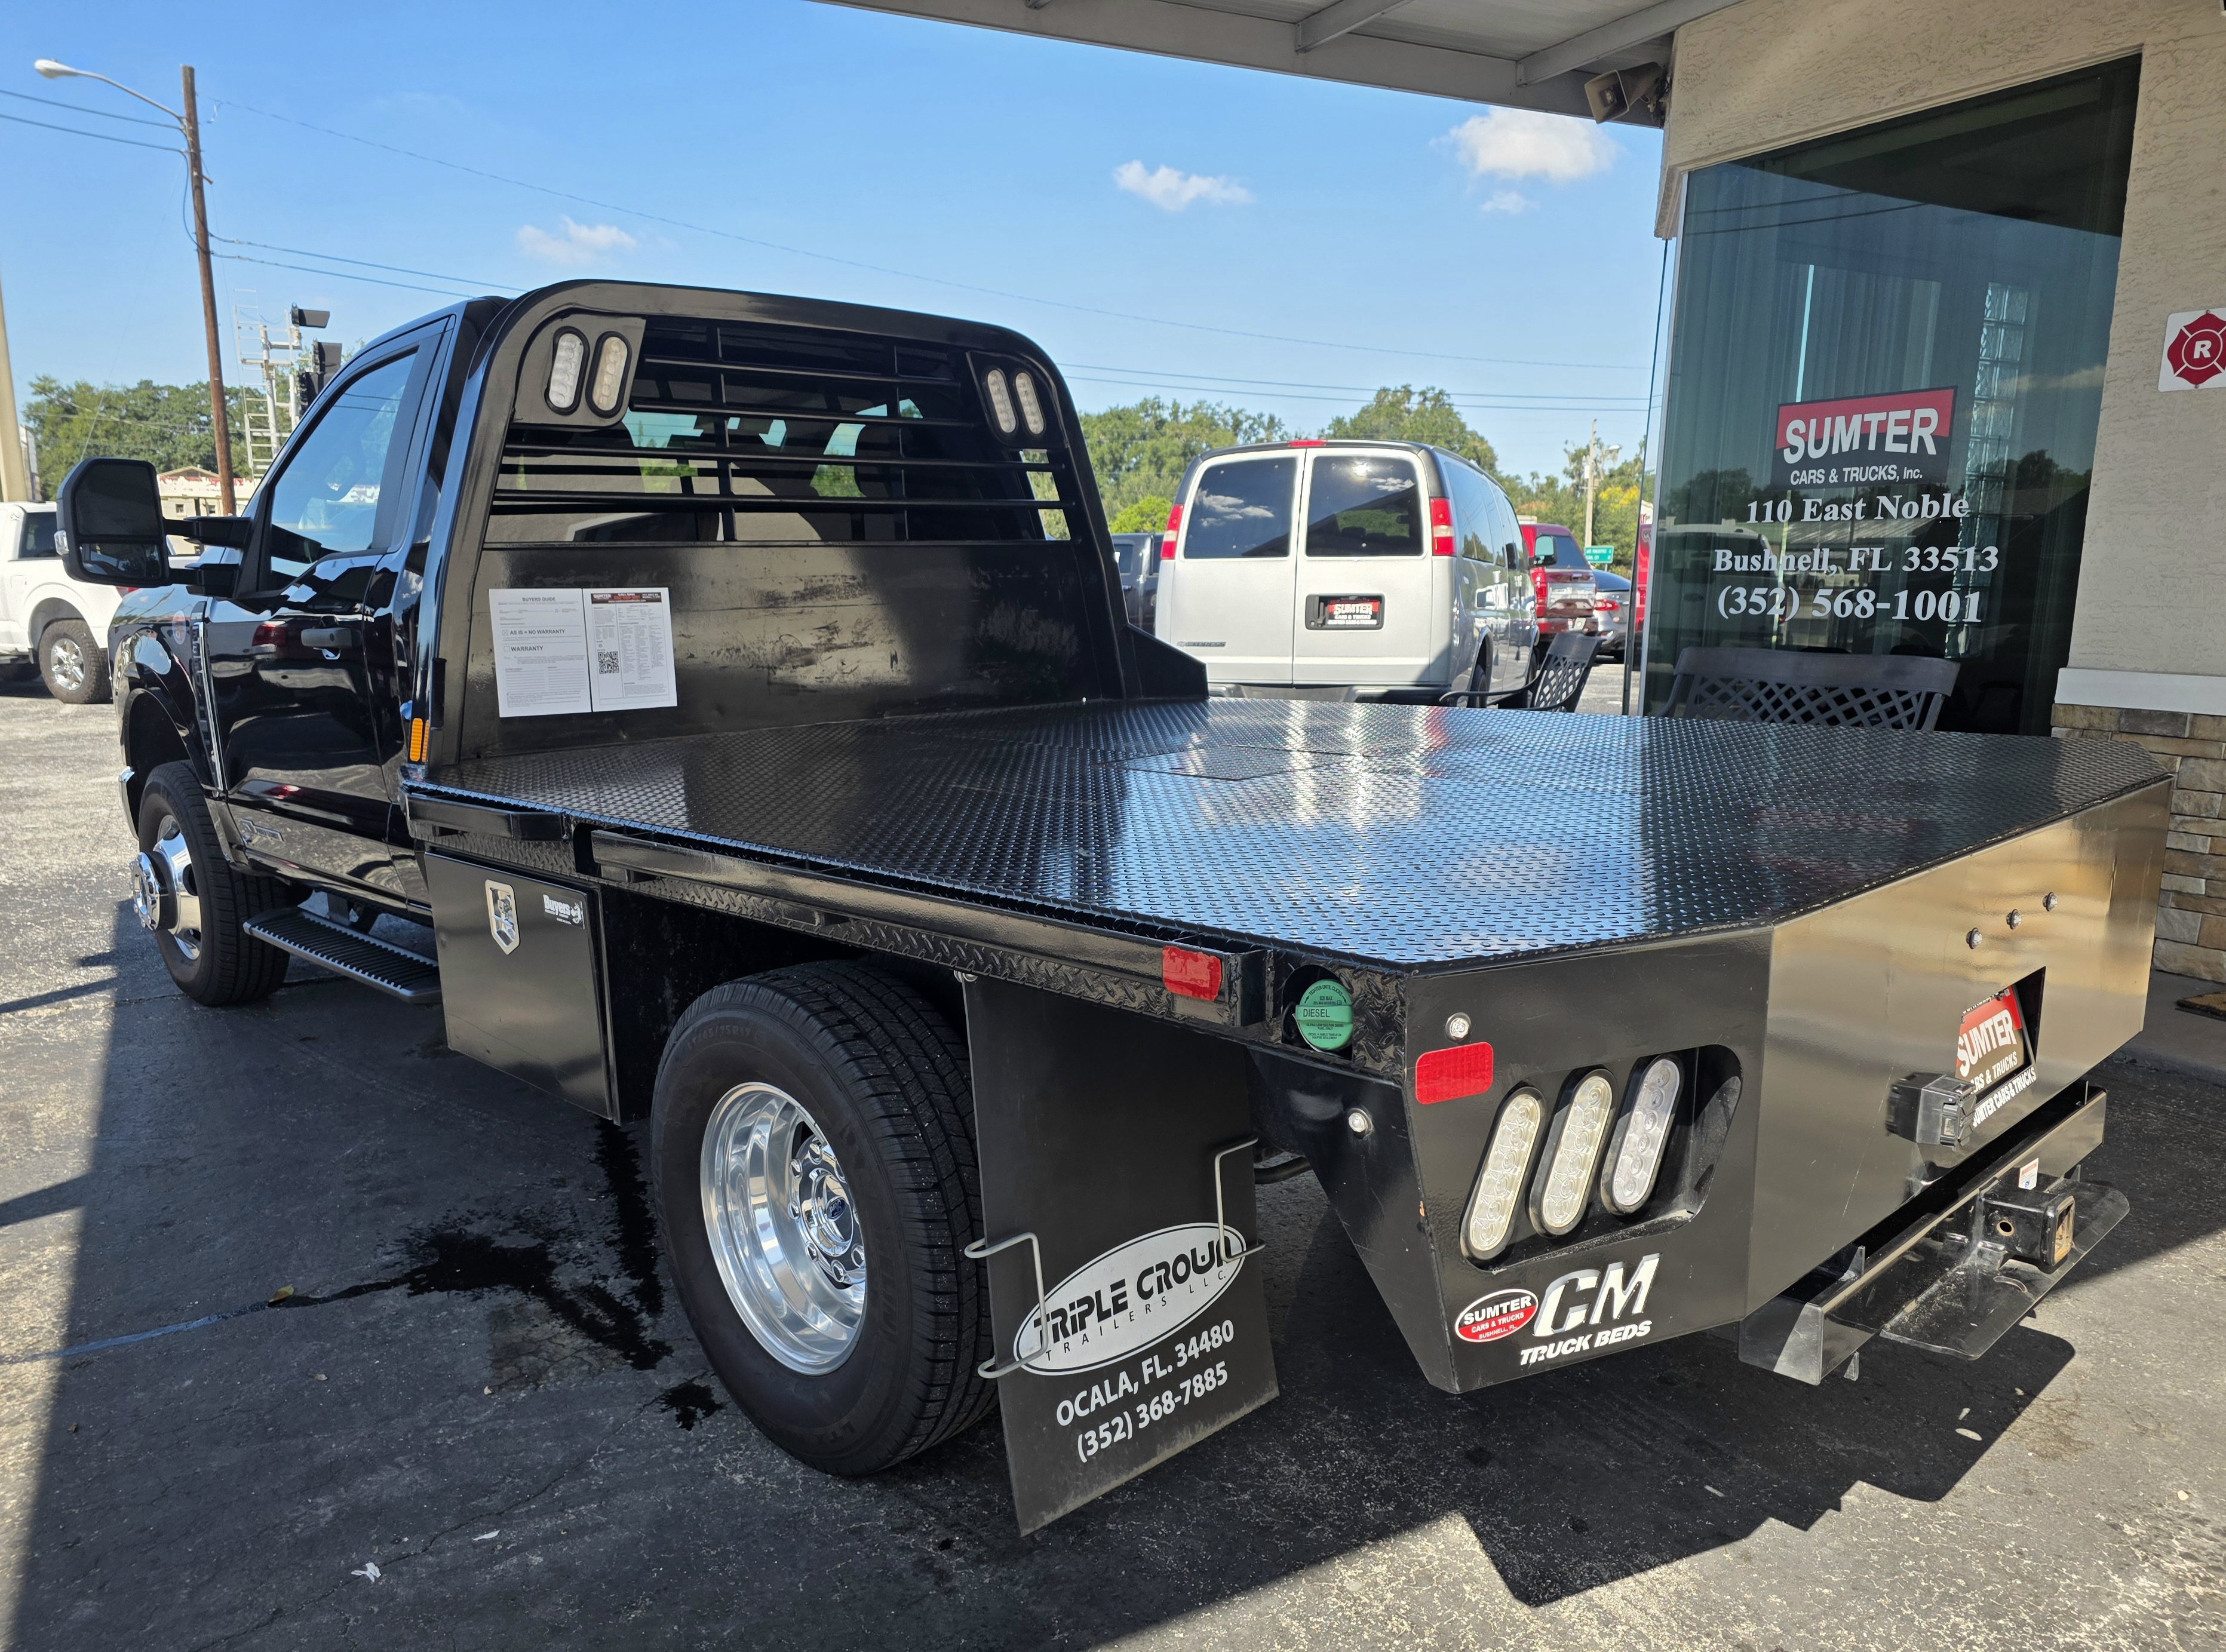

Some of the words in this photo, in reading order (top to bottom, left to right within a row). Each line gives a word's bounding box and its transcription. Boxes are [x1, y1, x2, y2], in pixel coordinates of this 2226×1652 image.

[2193, 340, 2212, 359] R
[1783, 407, 1939, 464] SUMTER
[1790, 468, 1825, 486] CARS
[1828, 470, 1838, 484] &
[1843, 464, 1900, 483] TRUCKS,
[1903, 466, 1923, 480] Inc.
[1746, 499, 1792, 524] 110
[1803, 497, 1866, 521] East
[1874, 493, 1969, 520] Noble
[1713, 546, 1838, 575] Bushnell,
[1847, 547, 1892, 572] FL
[1902, 545, 1999, 572] 33513
[1333, 603, 1373, 615] SUMTER
[1718, 585, 1800, 619] (352)
[1812, 588, 1982, 622] 568-1001
[543, 894, 571, 916] Buyers
[1303, 1009, 1330, 1018] DIESEL
[1957, 1009, 2017, 1077] SUMTER
[1986, 1069, 1992, 1085] &
[1992, 1051, 2018, 1079] TRUCKS
[1994, 1085, 2011, 1109] CARS
[2013, 1067, 2037, 1094] TRUCKS
[1034, 1278, 1128, 1348] TRIPLE
[1137, 1236, 1232, 1301] CROWN
[1533, 1252, 1663, 1338] CM
[1464, 1295, 1532, 1325] SUMTER
[1471, 1322, 1489, 1333] CARS
[1497, 1312, 1524, 1325] TRUCKS
[1045, 1295, 1167, 1361] TRAILERS
[1479, 1327, 1508, 1340] BUSHNELL,
[1519, 1333, 1592, 1366] TRUCK
[1593, 1320, 1653, 1348] BEDS
[1056, 1370, 1139, 1427] OCALA,
[1141, 1354, 1173, 1385] FL.
[1174, 1319, 1235, 1368] 34480
[1077, 1412, 1134, 1463] (352)
[1136, 1361, 1228, 1429] 368-7885
